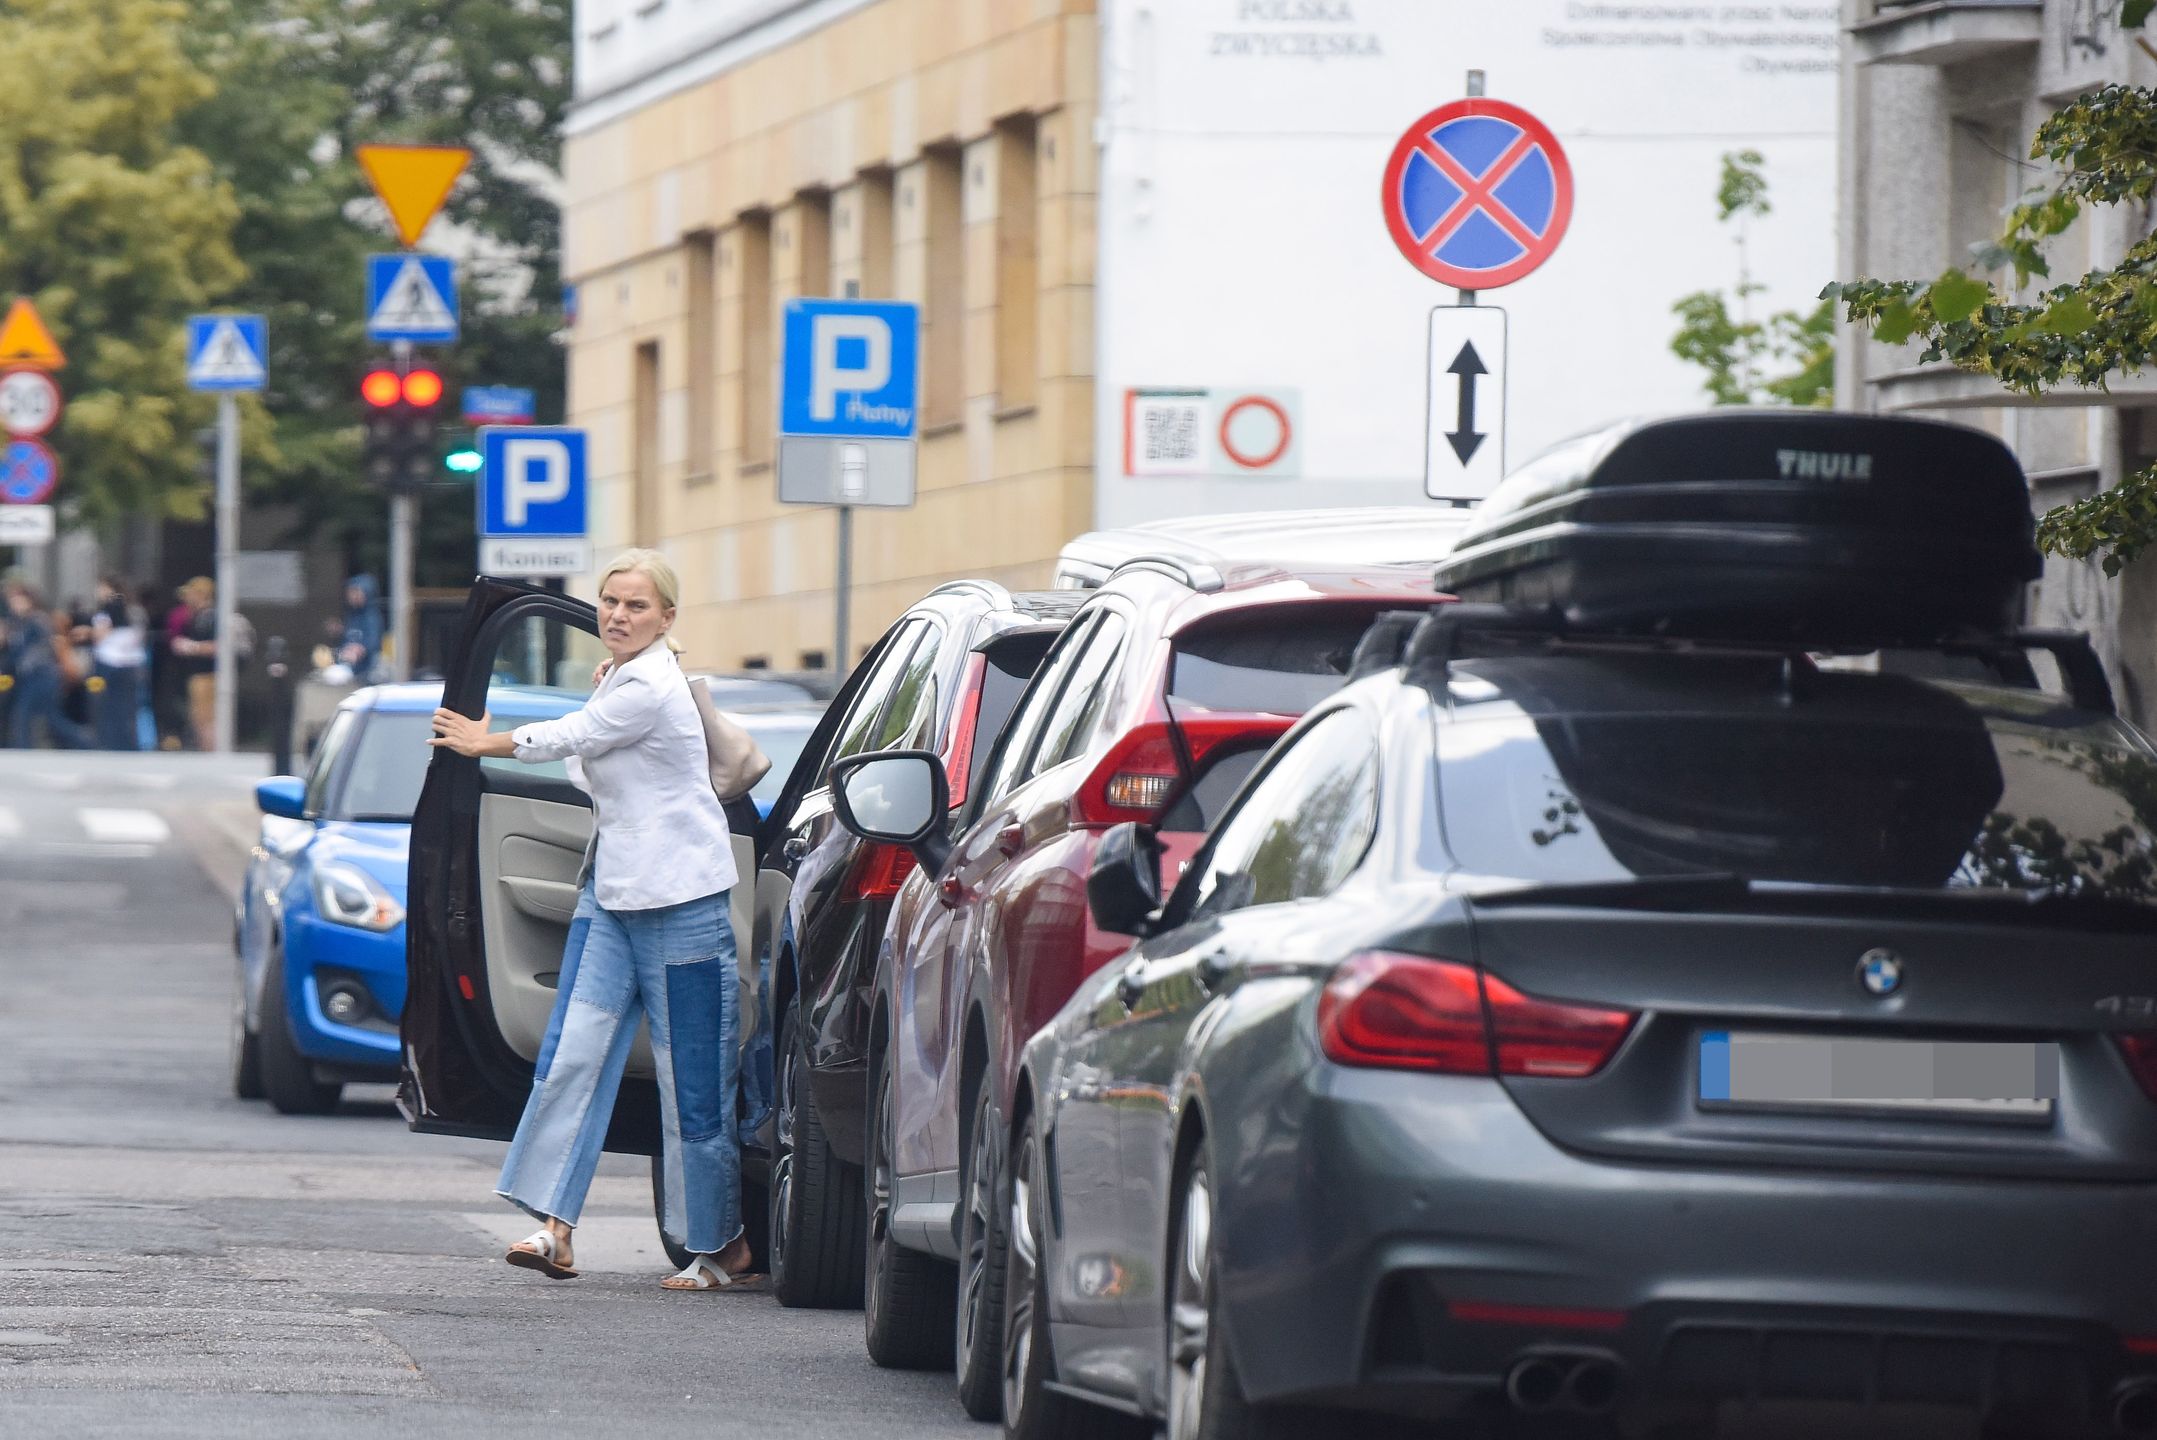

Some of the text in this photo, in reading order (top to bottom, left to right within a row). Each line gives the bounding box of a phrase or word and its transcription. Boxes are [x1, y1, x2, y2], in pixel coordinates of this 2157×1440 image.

[809, 315, 892, 420] P
[503, 440, 570, 526] P
[1778, 449, 1873, 479] THULE
